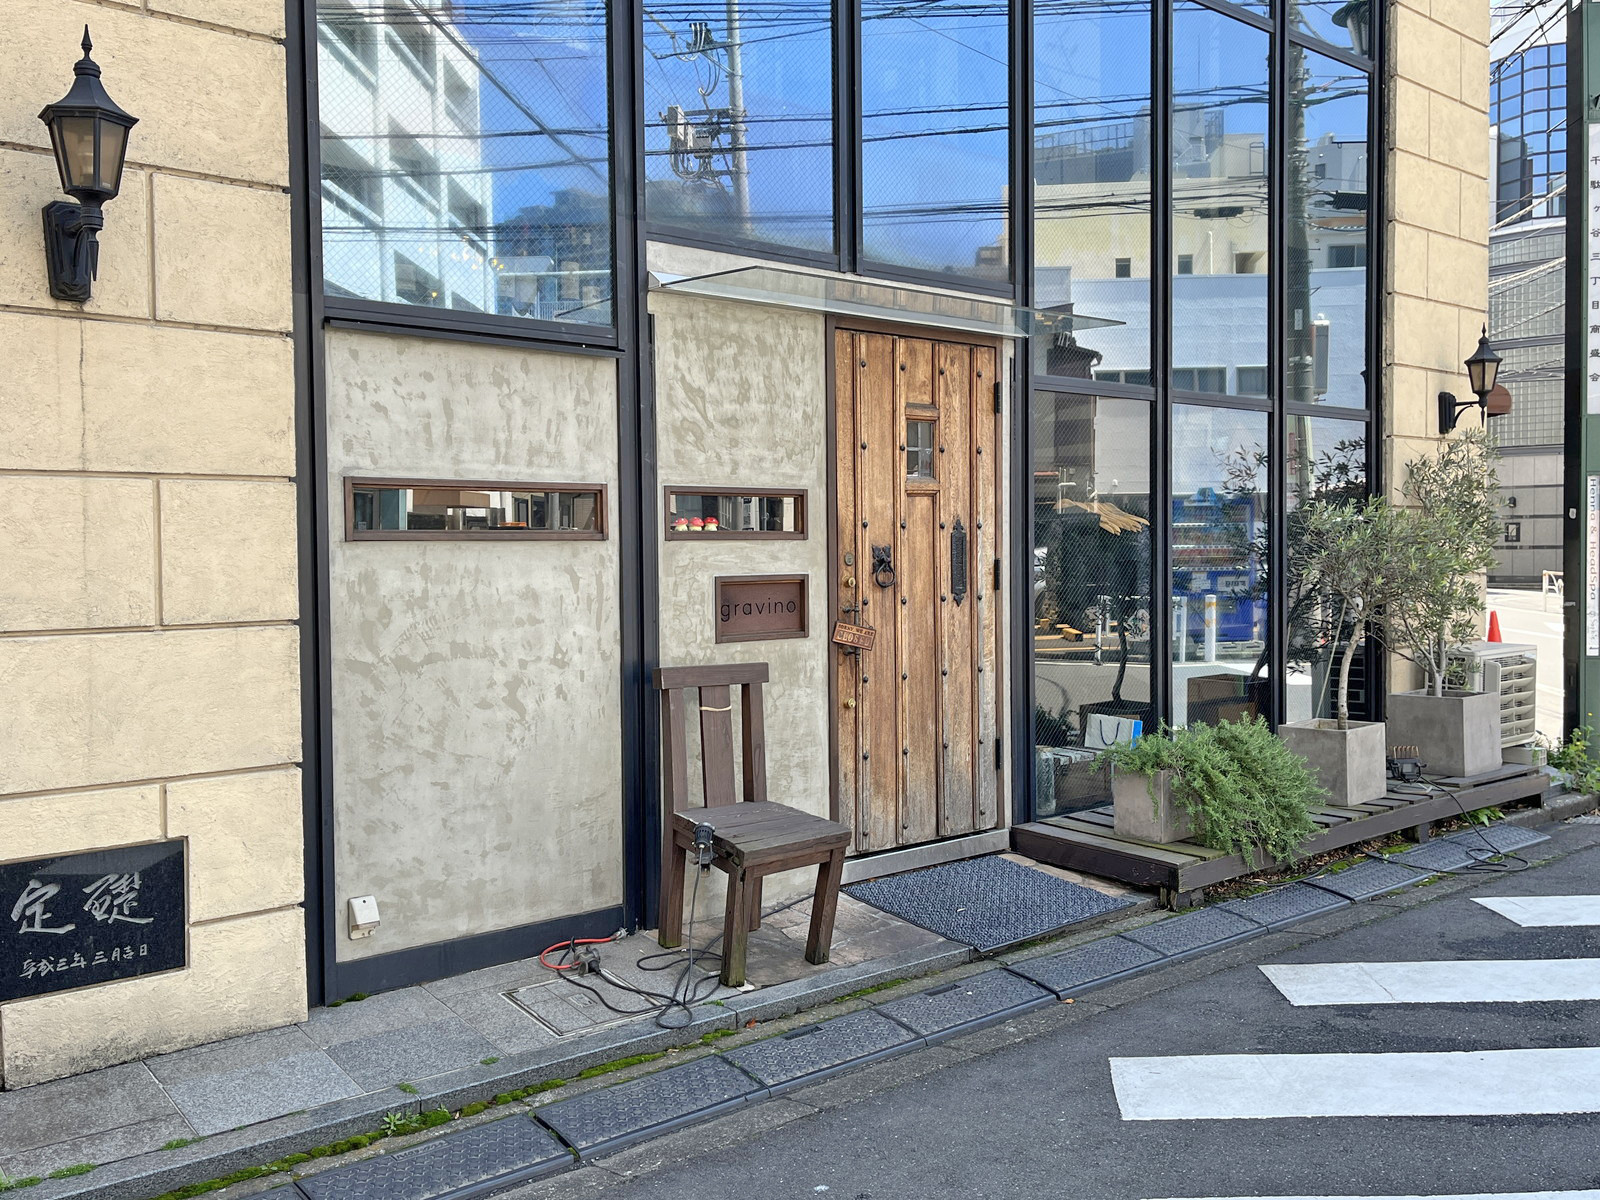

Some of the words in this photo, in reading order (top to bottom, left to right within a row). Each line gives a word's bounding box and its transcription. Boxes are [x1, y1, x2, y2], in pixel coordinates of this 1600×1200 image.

[1590, 527, 1597, 536] &
[1589, 541, 1597, 600] HeadSpa
[720, 597, 797, 622] gravino
[837, 631, 870, 646] CLOSED
